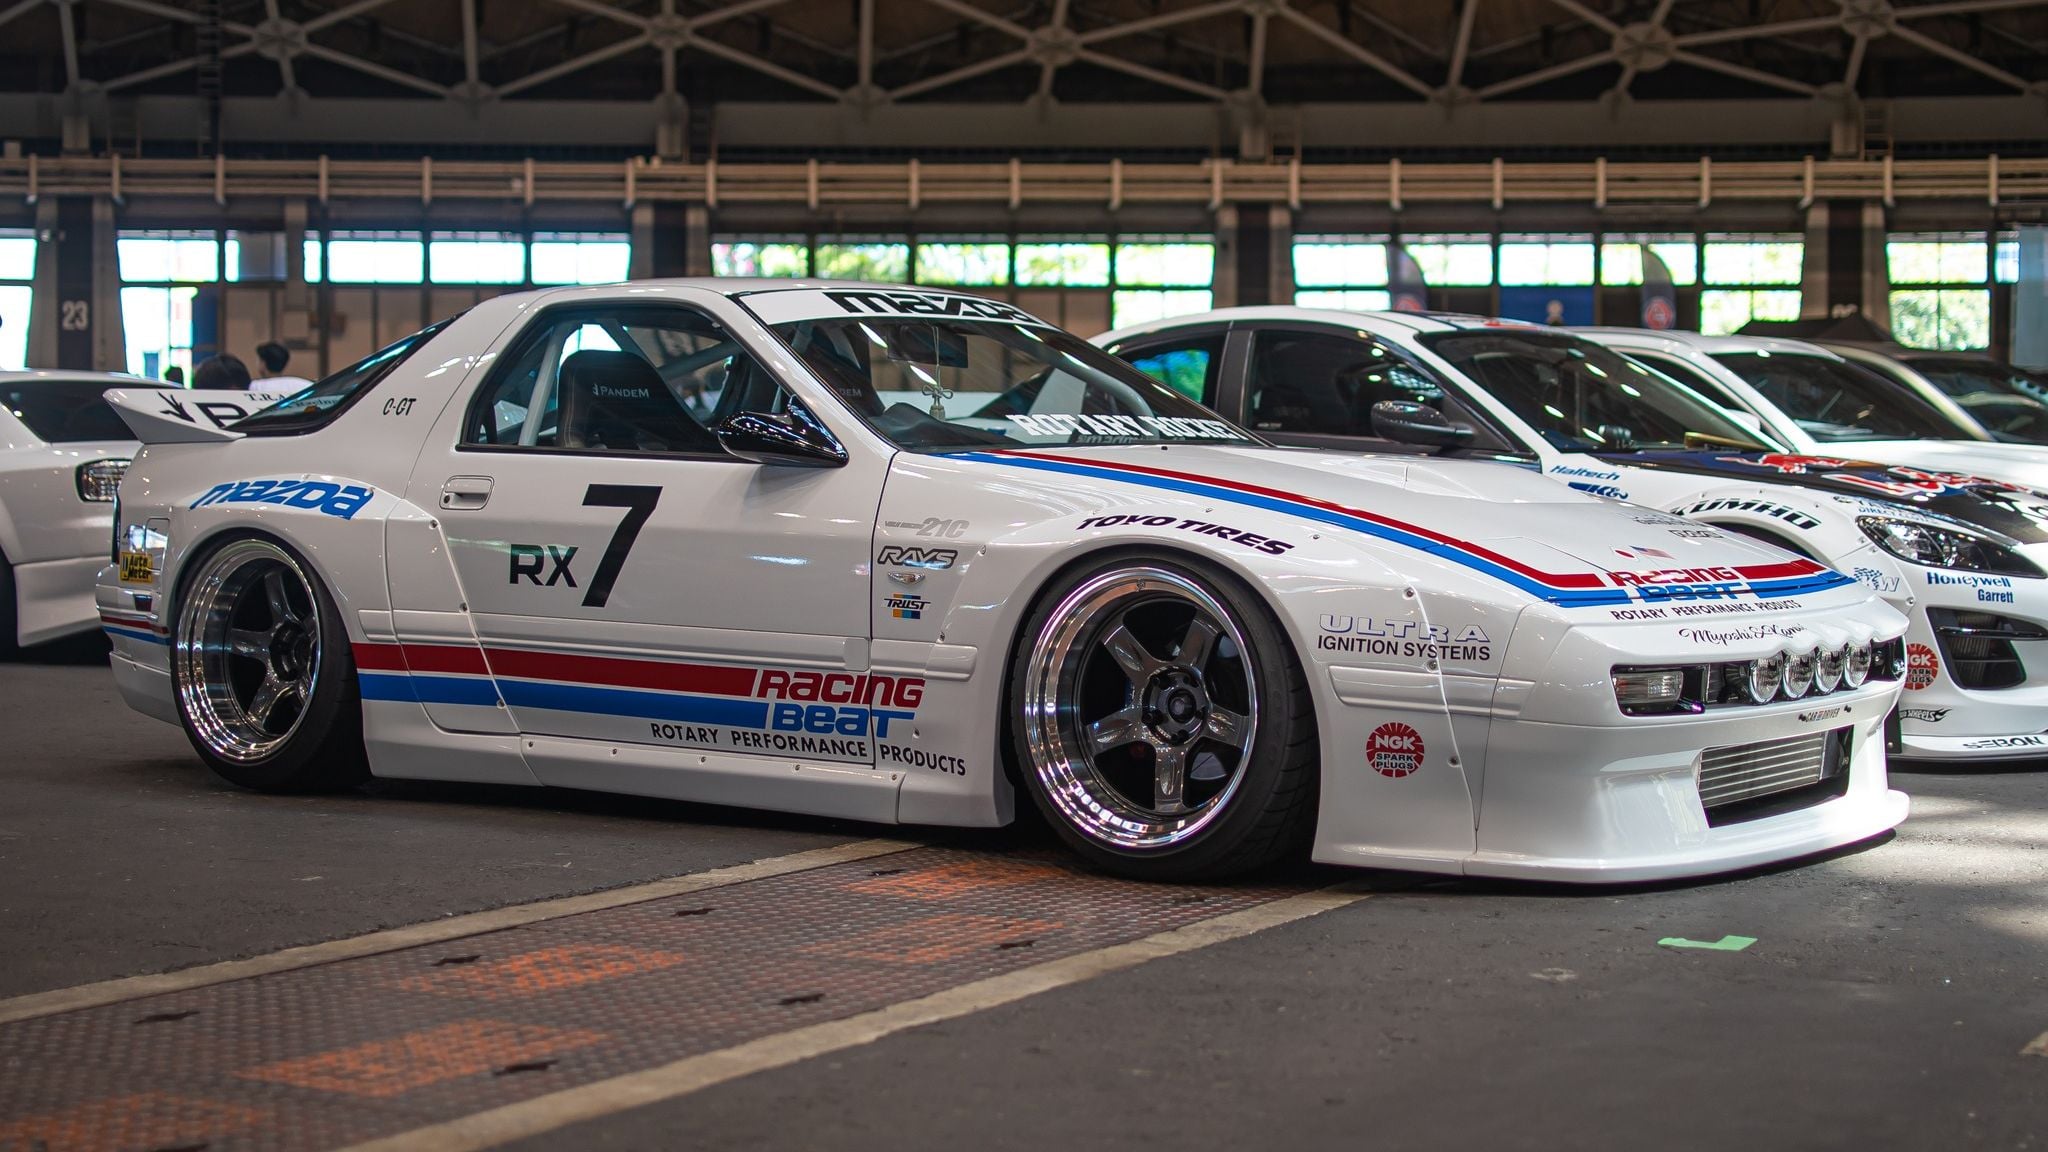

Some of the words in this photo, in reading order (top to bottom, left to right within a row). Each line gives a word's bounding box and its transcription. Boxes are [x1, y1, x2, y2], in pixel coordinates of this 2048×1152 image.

[62, 300, 88, 330] 23
[600, 385, 650, 399] PANDEM
[1005, 414, 1148, 436] ROTARY
[1550, 465, 1621, 481] Haltech
[1076, 514, 1178, 531] TOYO
[1176, 519, 1295, 555] TIRES
[509, 544, 579, 588] RX
[581, 483, 664, 608] 7
[877, 545, 958, 569] RAYS
[1926, 571, 2012, 588] Honeywell
[1977, 589, 2014, 603] Garrett
[1610, 609, 1666, 620] ROTARY
[1671, 603, 1753, 617] PERFORMANCE
[1754, 599, 1802, 611] PRODUCTS
[1319, 613, 1491, 643] ULTRA
[1318, 635, 1400, 656] IGNITION
[1403, 641, 1491, 661] SYSTEMS
[1907, 654, 1931, 666] GK
[650, 722, 719, 744] ROTARY
[730, 730, 869, 758] PERFORMANCE
[879, 743, 967, 776] PRODUCTS
[1375, 735, 1416, 751] NGK
[1962, 736, 2046, 749] SEBON
[1375, 752, 1415, 763] SPARK
[1375, 762, 1415, 771] PLUGS
